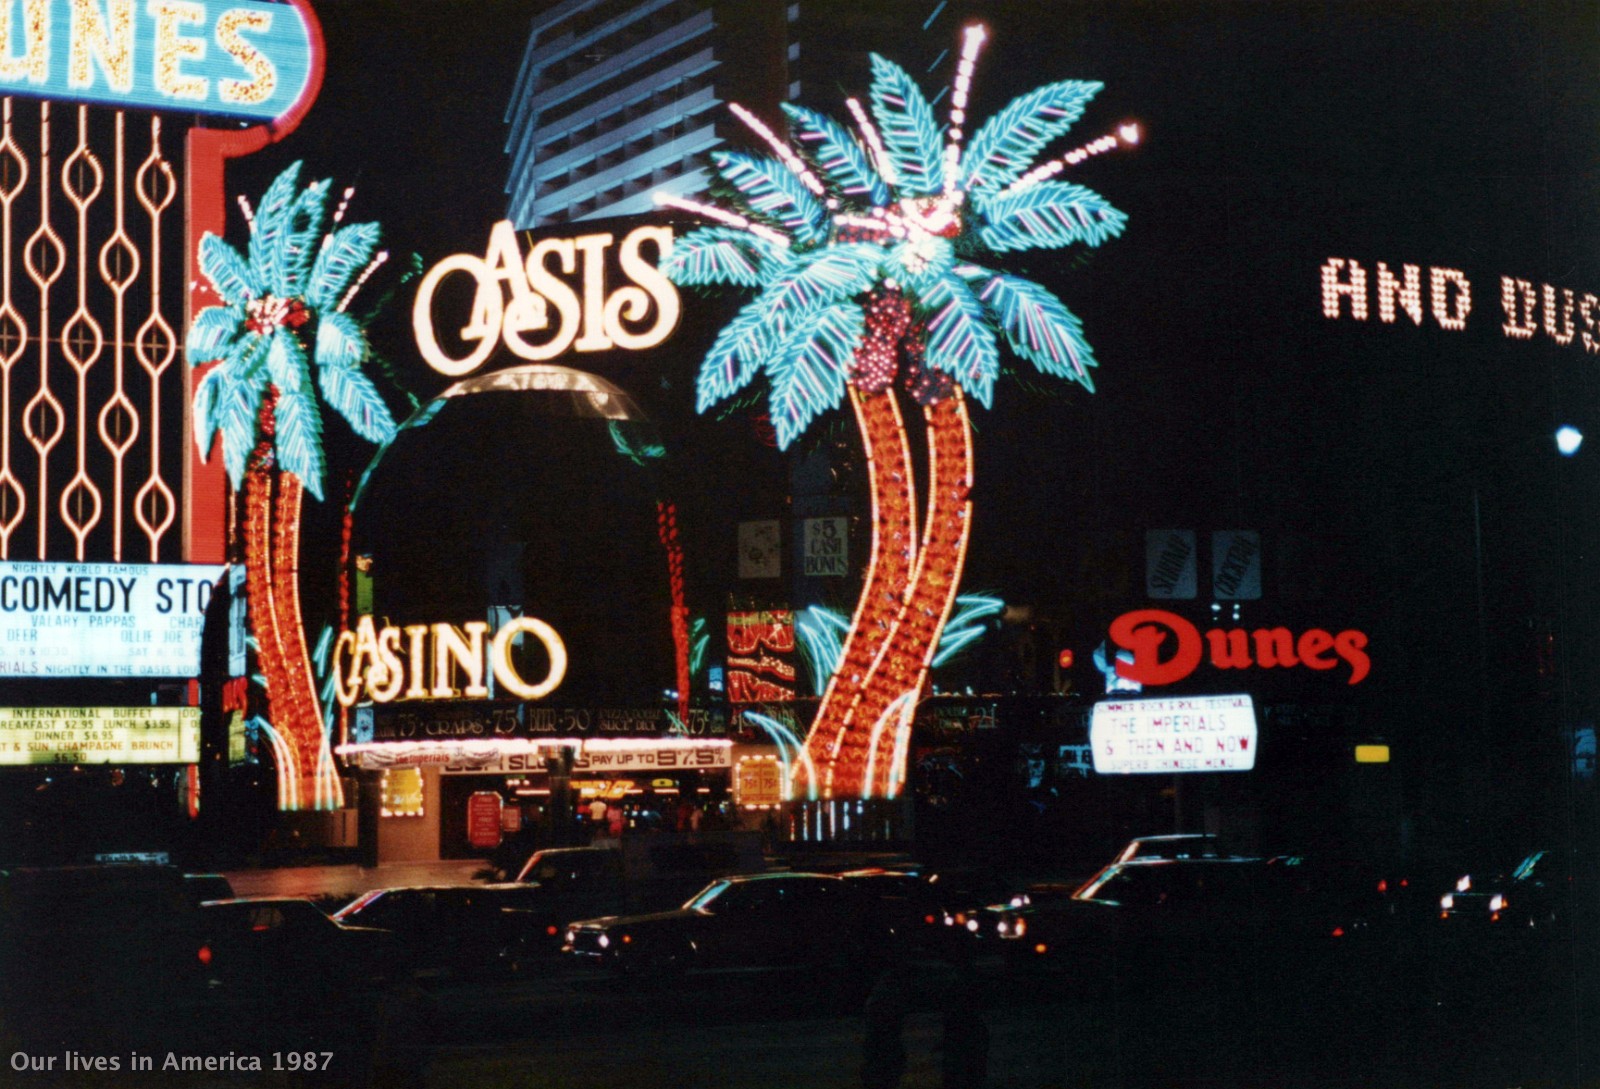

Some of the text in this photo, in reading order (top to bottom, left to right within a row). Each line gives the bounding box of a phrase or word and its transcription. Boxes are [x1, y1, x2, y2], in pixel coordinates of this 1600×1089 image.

[412, 219, 681, 377] OASIS
[1321, 257, 1472, 331] AND
[811, 538, 842, 556] CASH
[12, 563, 149, 576] NIGHTLY WORLD FAMOUS
[805, 556, 848, 575] BONUS
[1, 575, 137, 614] COMEDY
[31, 615, 79, 628] VALARY
[88, 615, 136, 629] PAPPAS
[7, 628, 38, 642] DEER
[163, 630, 183, 643] JOE
[1108, 609, 1370, 685] Dunes
[45, 664, 90, 675] NIGHTLY
[97, 665, 107, 675] IN
[114, 665, 133, 675] THE
[139, 665, 171, 675] OASIS
[334, 615, 568, 706] CASINO
[12, 708, 153, 719] INTERNATIONAL BUFFET
[425, 718, 484, 736] CRAPS
[529, 708, 558, 732] BEER
[103, 719, 137, 730] LUNCH
[1111, 714, 1226, 735] THE IMPERIALS
[34, 730, 74, 741] DINNER
[27, 741, 48, 752] SUN
[57, 741, 123, 752] CHAMPAGNE
[131, 740, 173, 750] BRUNCH
[1128, 738, 1165, 755] THEN
[1173, 737, 1203, 753] AND
[1216, 736, 1250, 752] NOW
[508, 752, 590, 771] SLS
[592, 754, 613, 766] PAY
[617, 754, 633, 765] UP
[637, 753, 655, 764] TO
